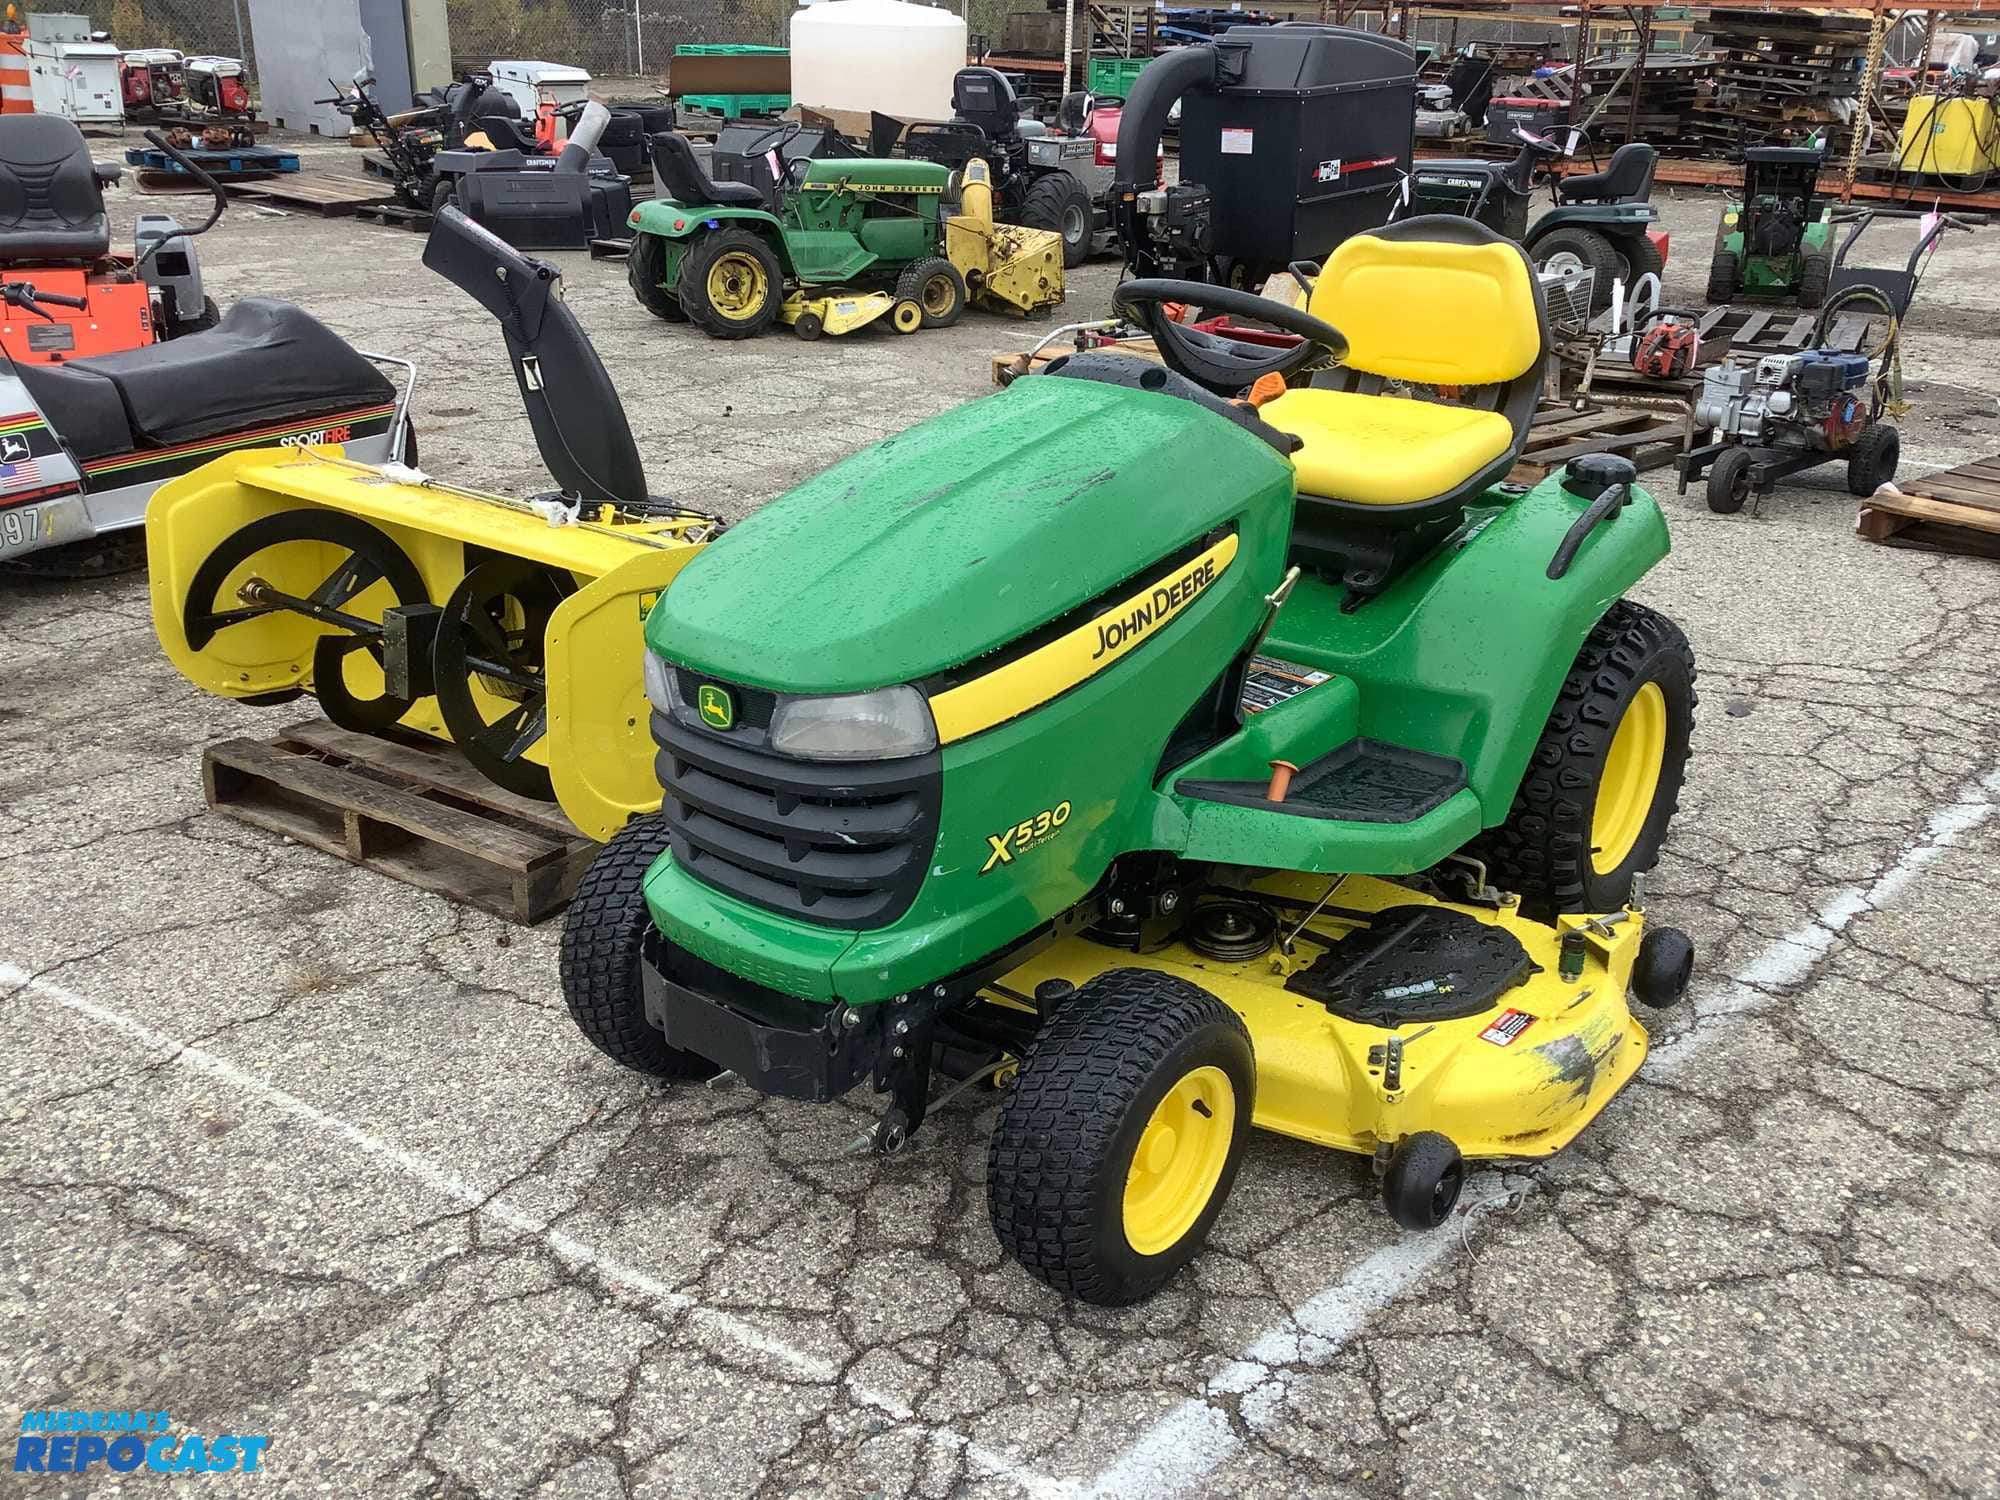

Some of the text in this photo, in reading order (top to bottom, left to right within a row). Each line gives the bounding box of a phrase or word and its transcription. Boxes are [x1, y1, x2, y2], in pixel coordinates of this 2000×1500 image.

[1092, 557, 1216, 660] JOHN DEERE
[978, 799, 1072, 875] X530
